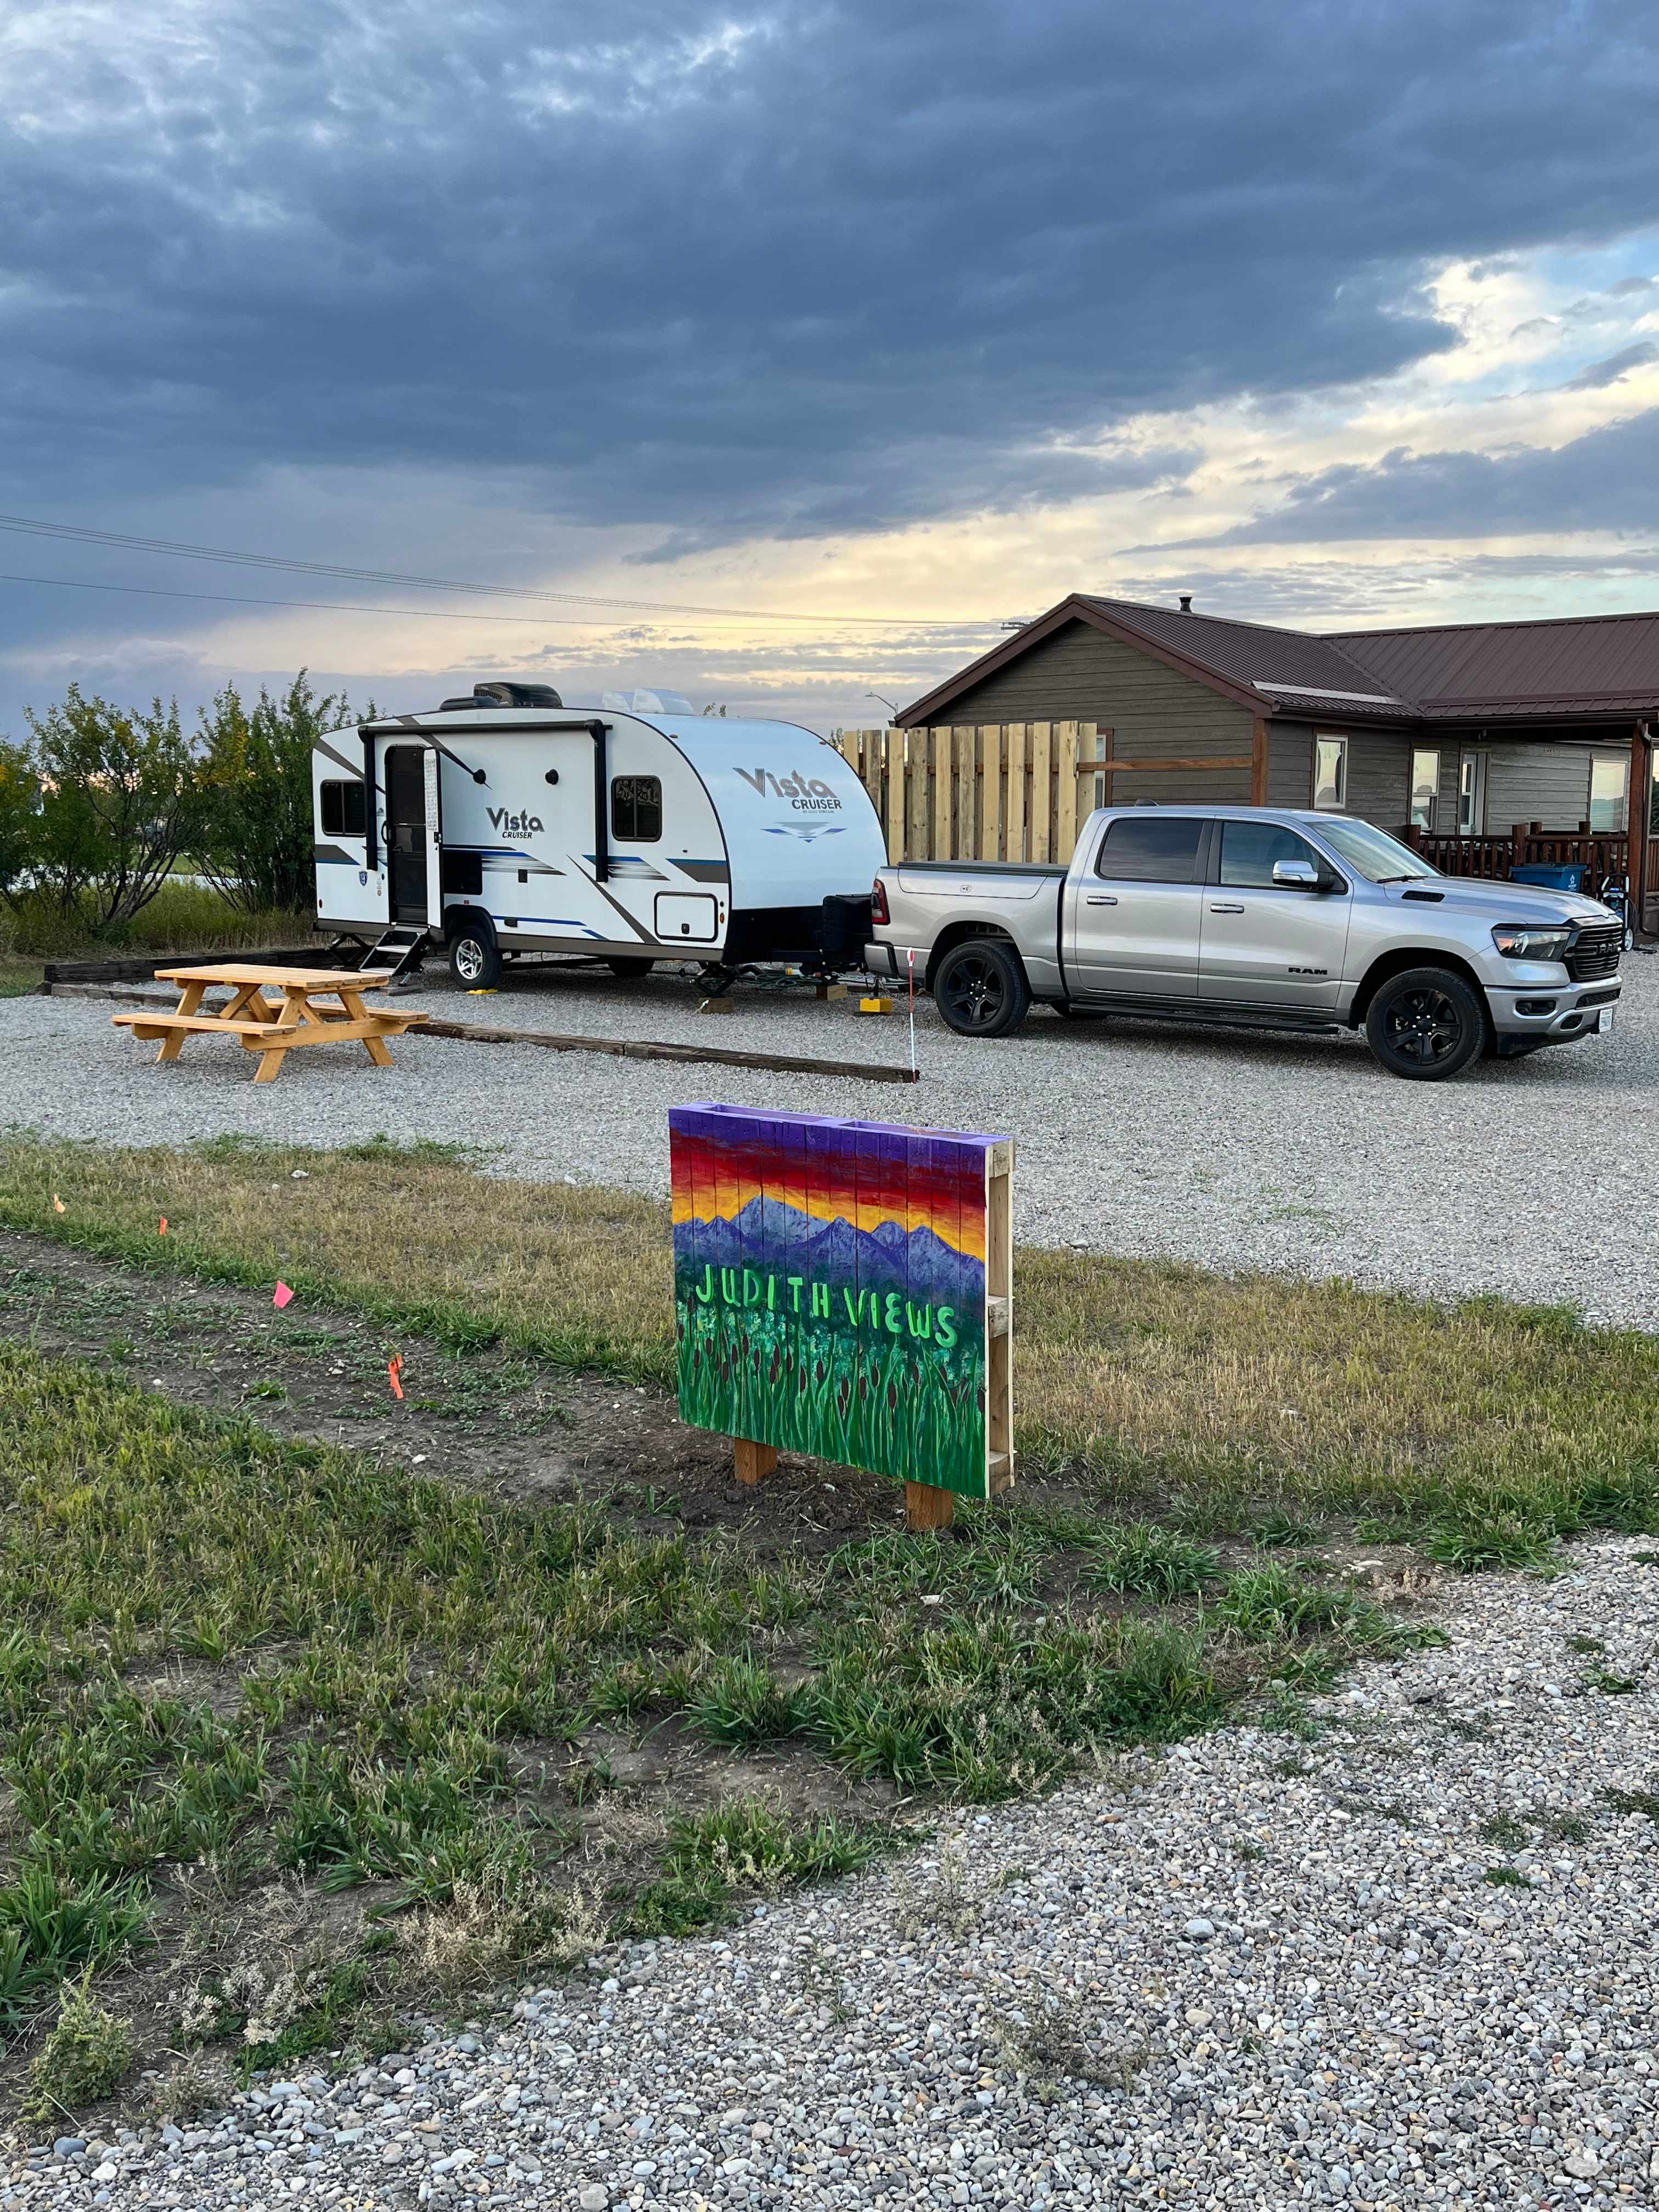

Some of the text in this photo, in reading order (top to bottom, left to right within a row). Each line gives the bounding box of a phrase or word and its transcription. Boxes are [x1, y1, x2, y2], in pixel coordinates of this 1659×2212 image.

[731, 768, 838, 798] Vista
[792, 799, 842, 809] CRUISER
[486, 807, 544, 832] Vista
[695, 1264, 958, 1349] JUDITH VIEWS
